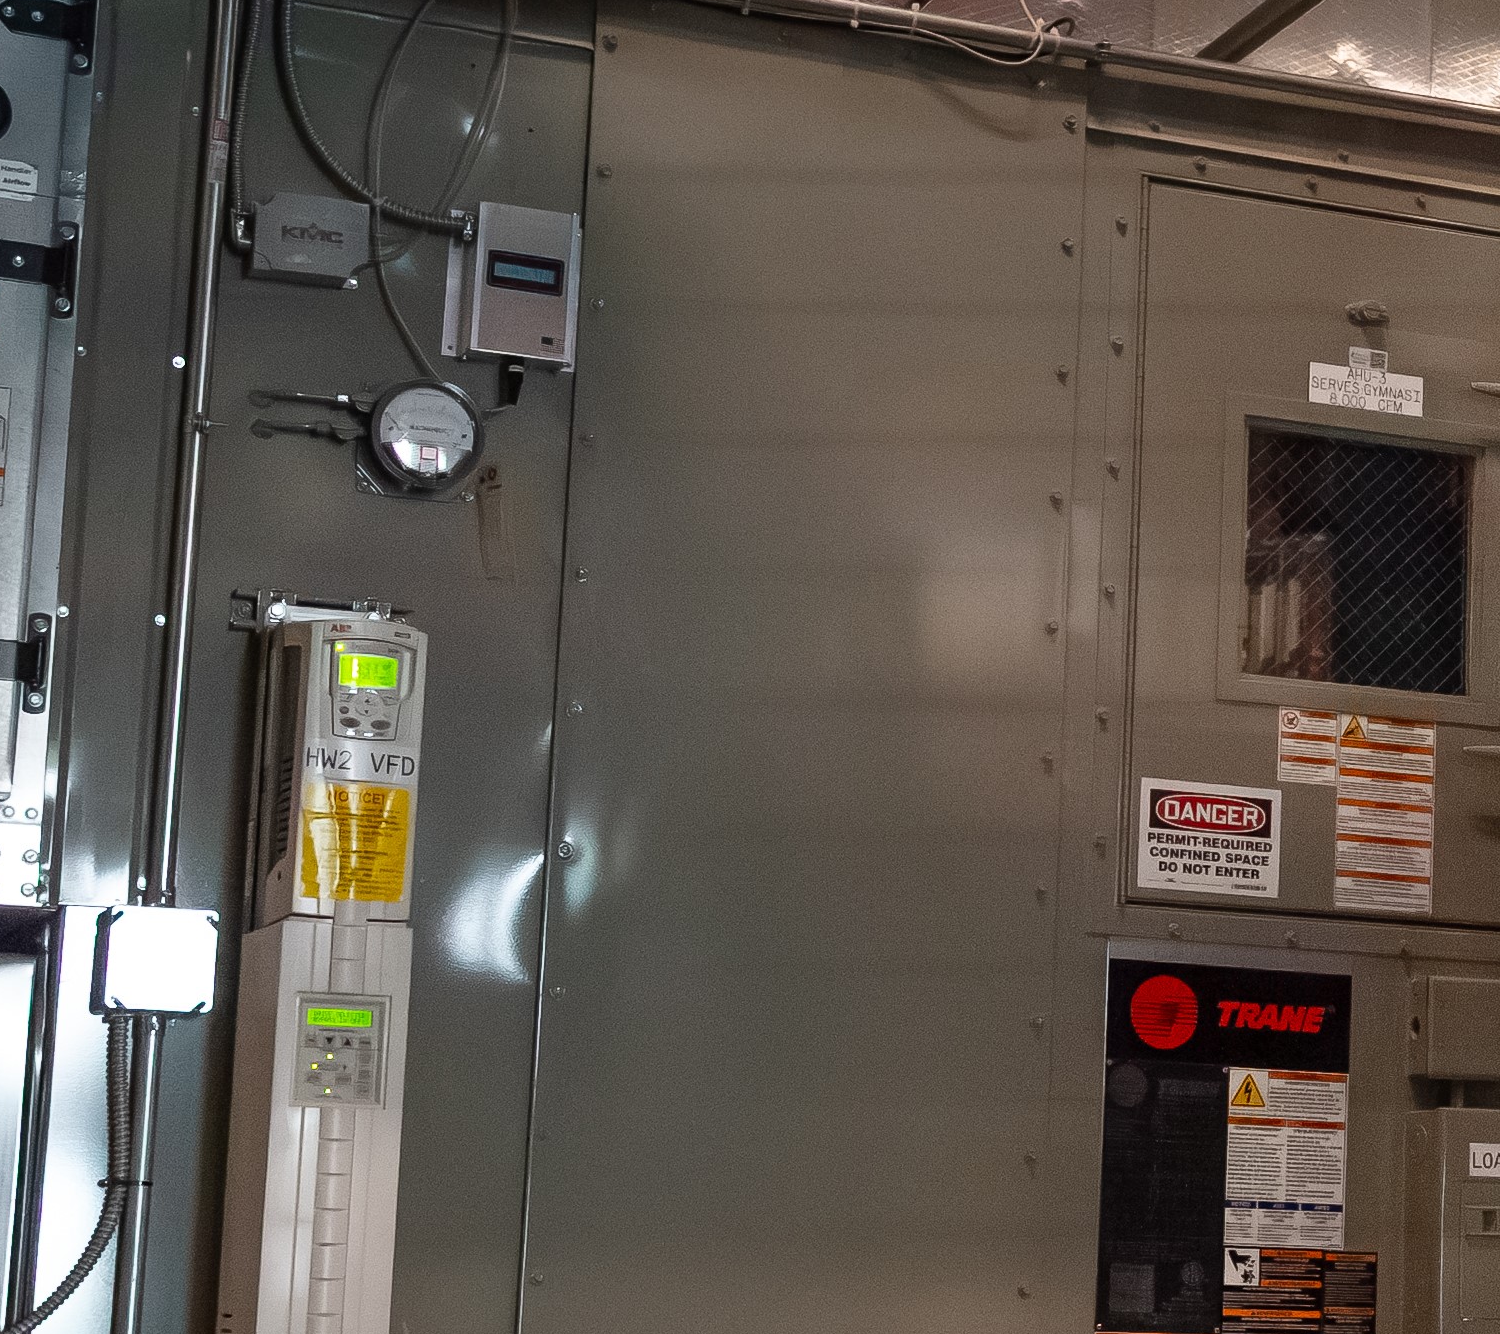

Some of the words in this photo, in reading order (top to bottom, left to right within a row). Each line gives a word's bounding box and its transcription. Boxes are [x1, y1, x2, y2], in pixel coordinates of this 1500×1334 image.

[281, 223, 344, 245] KMC
[1347, 367, 1387, 385] AHU-3
[1311, 375, 1360, 395] SERVES
[1364, 383, 1421, 404] GYMNASI
[1378, 399, 1403, 413] CFM
[306, 747, 352, 771] HW2
[371, 752, 415, 777] VFD
[1164, 799, 1258, 828] DANGER
[1147, 832, 1273, 853] PERMIT-REQUIRED
[1149, 846, 1221, 862] CONFINED
[1225, 853, 1270, 867] SPACE
[1158, 861, 1178, 873] DO
[1182, 863, 1211, 876] NOT
[1215, 866, 1260, 880] ENTER
[1216, 1000, 1326, 1034] TRANE
